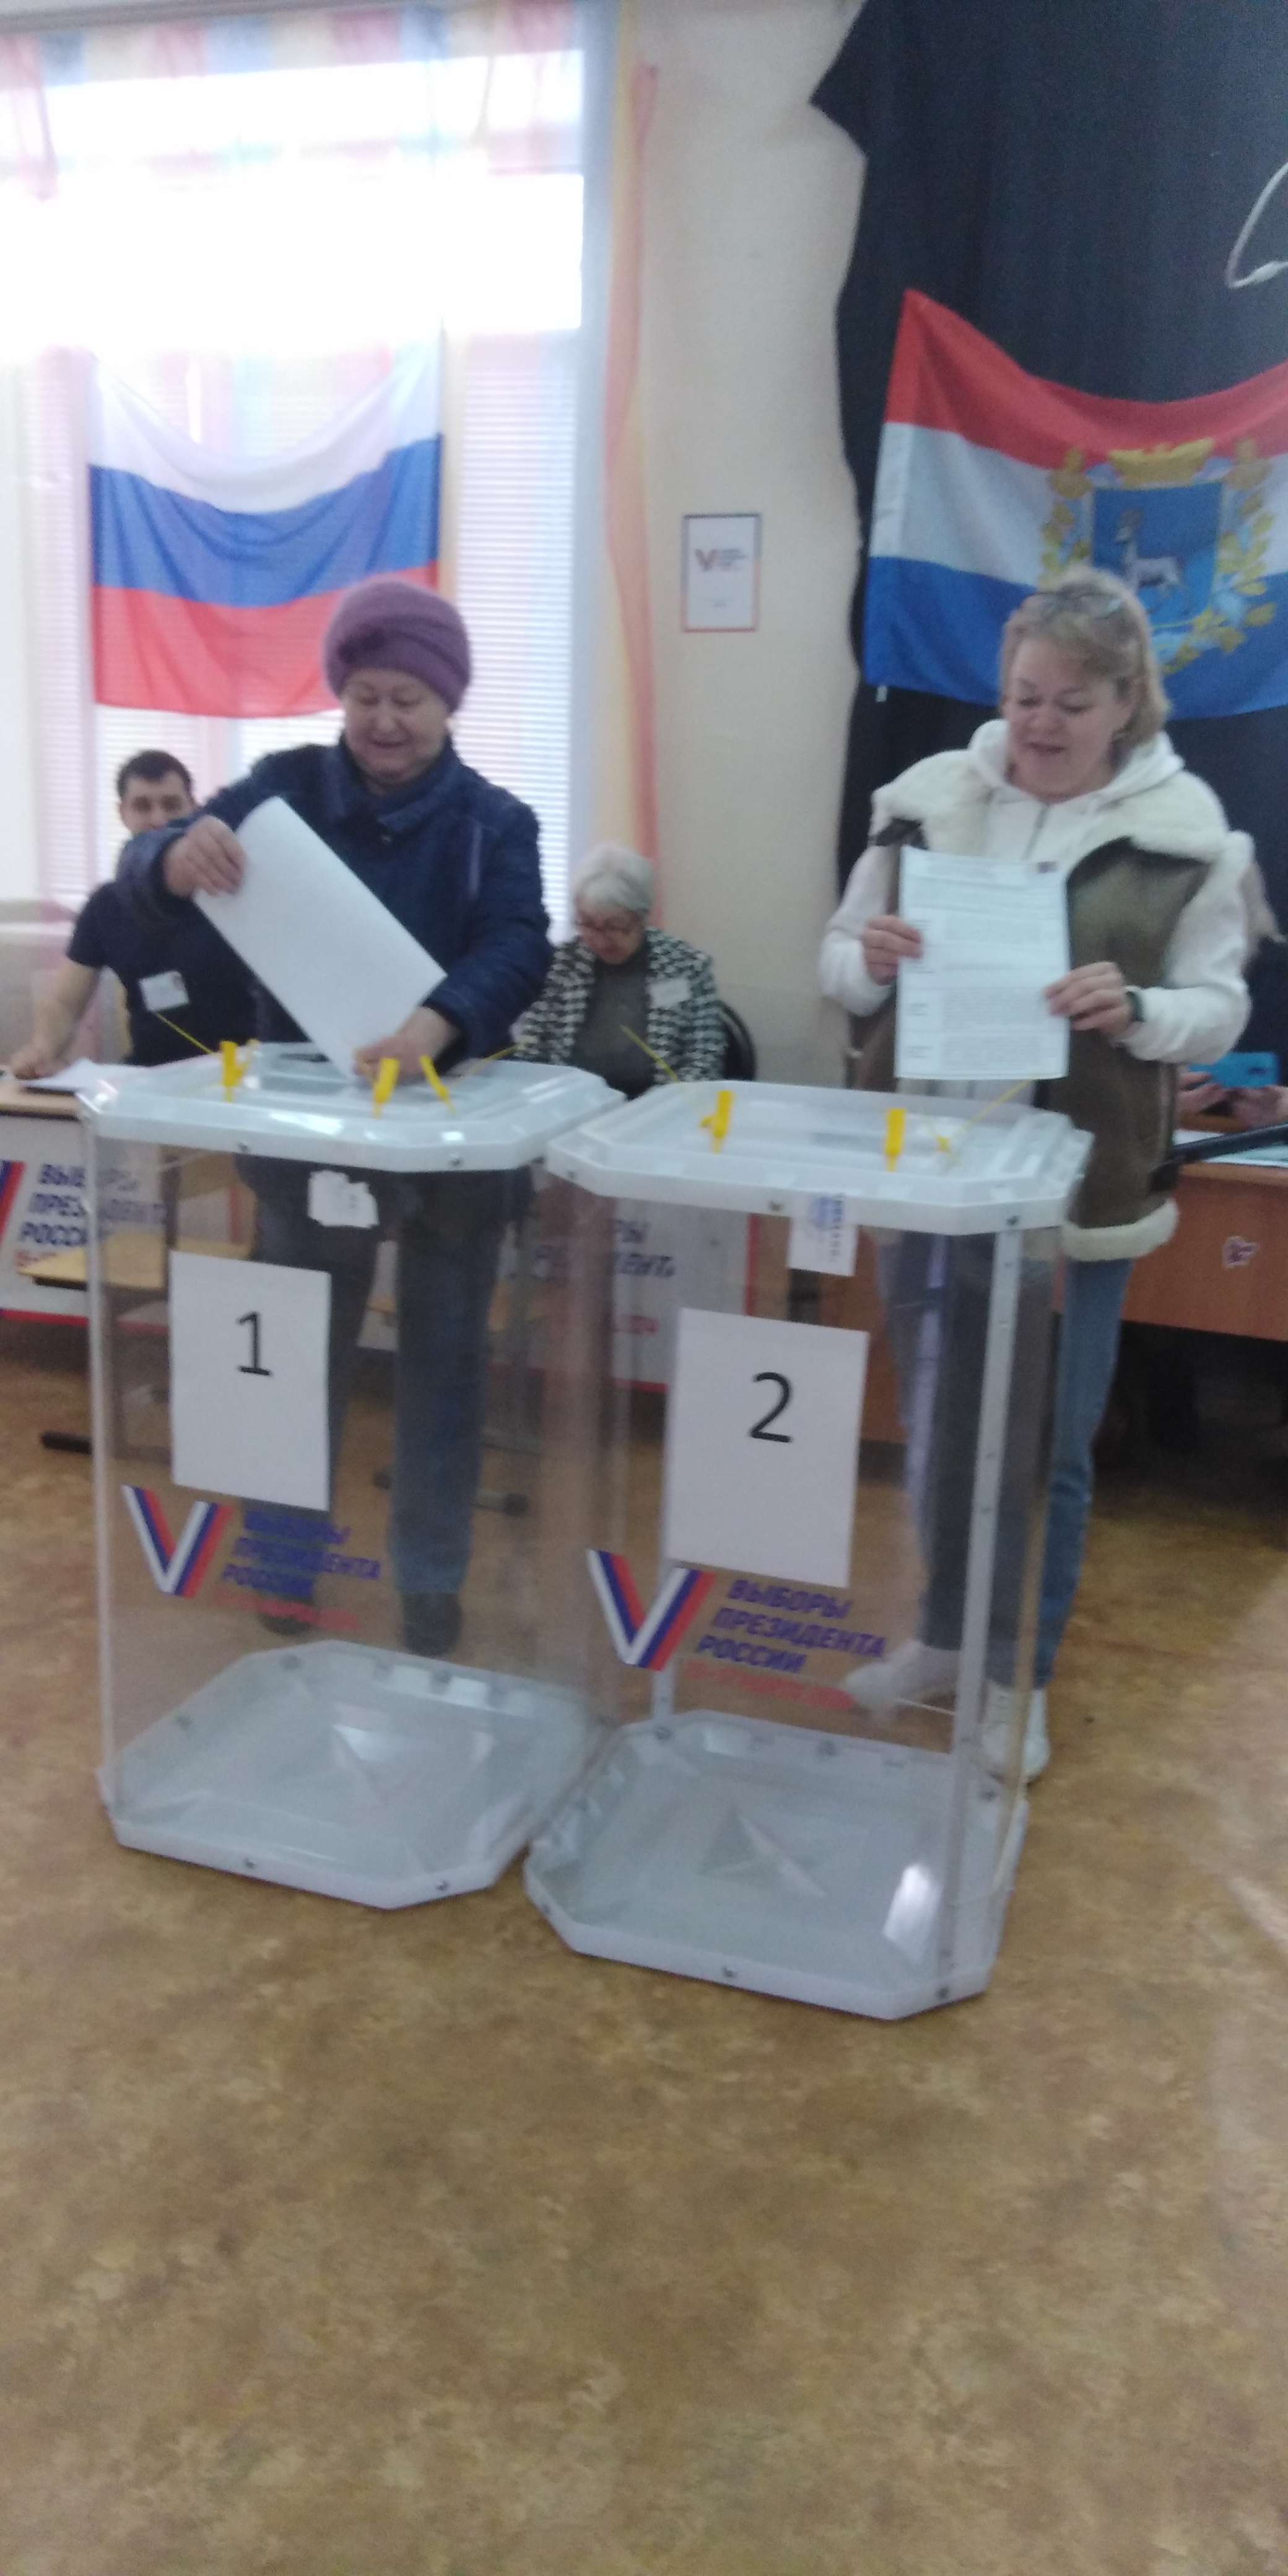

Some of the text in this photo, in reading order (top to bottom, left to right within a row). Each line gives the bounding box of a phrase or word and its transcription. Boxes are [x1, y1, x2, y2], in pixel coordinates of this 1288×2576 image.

[237, 1311, 272, 1377] 1
[748, 1372, 793, 1443] 2
[726, 1579, 854, 1619] ВЫБОРЫ
[694, 1634, 807, 1674] РОССИИ
[711, 1606, 886, 1658] ПРЕЗИДЕНТА
